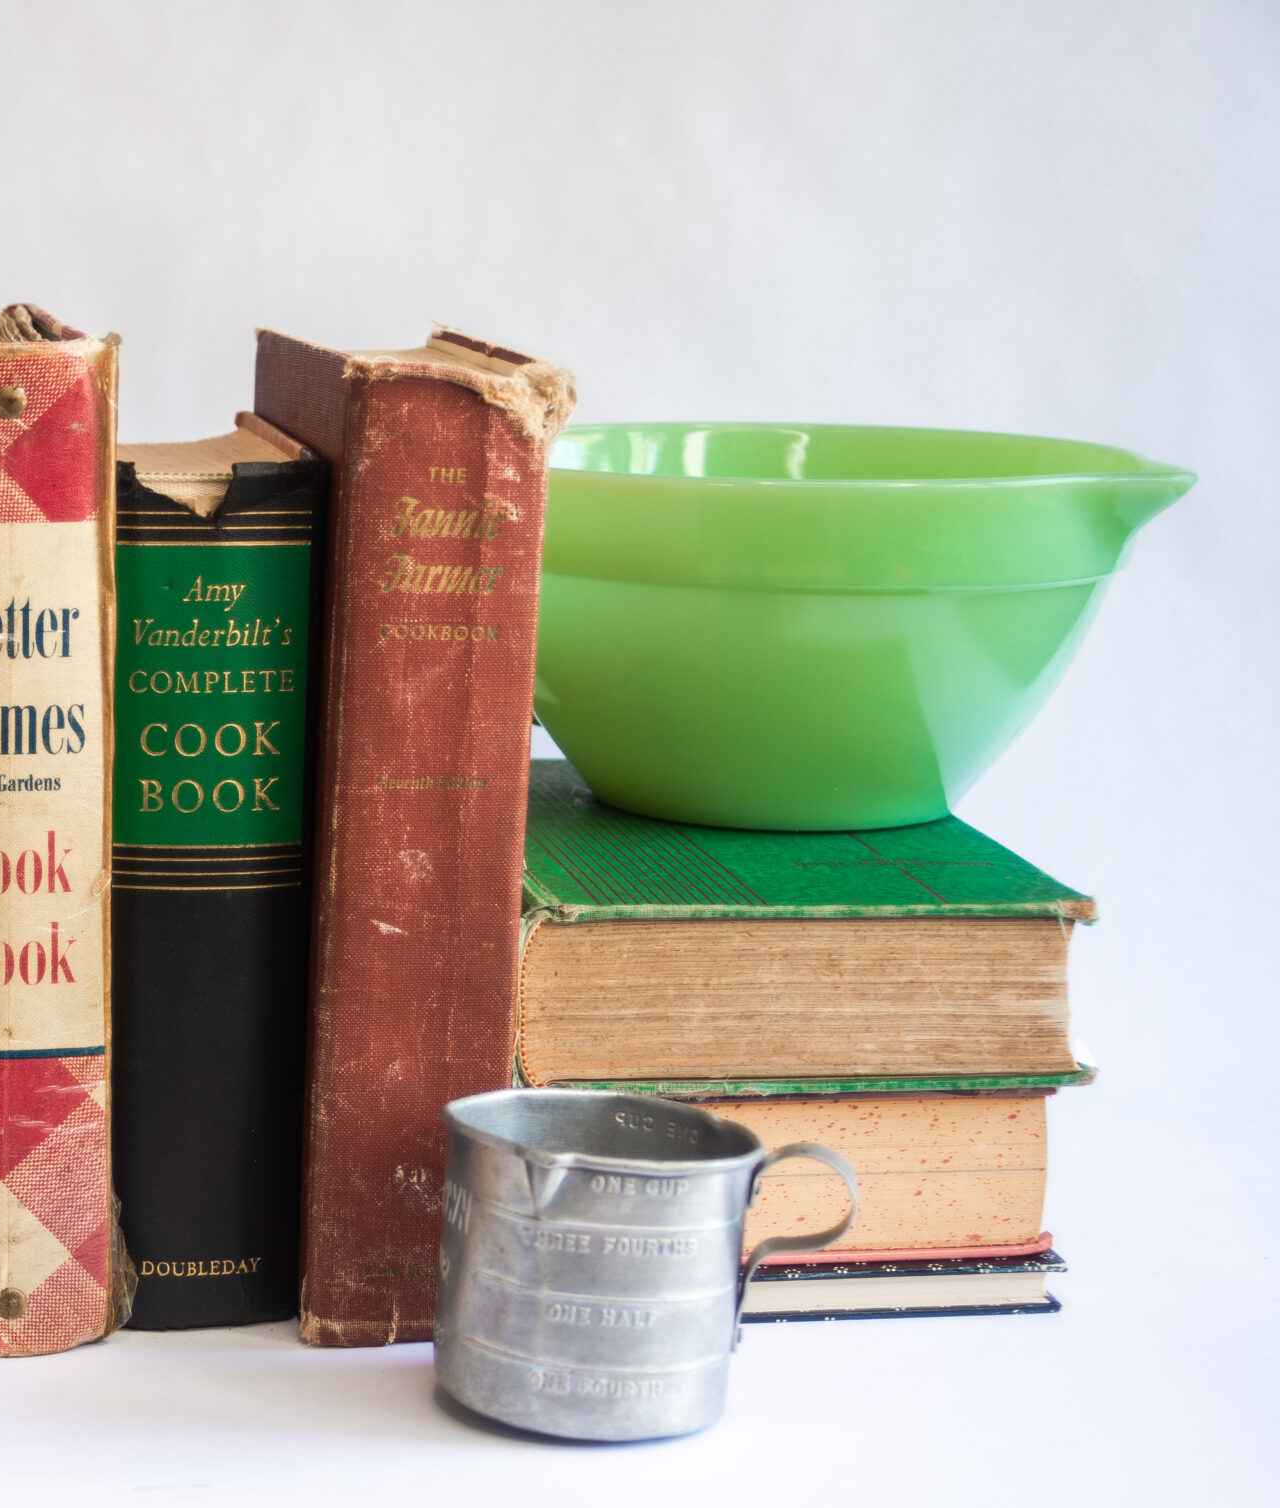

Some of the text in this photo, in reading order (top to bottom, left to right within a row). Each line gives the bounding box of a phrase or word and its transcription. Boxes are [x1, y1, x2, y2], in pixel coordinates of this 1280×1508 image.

[429, 466, 467, 484] THE
[390, 496, 504, 539] Fannie
[381, 552, 504, 595] Farmer
[182, 574, 247, 612] Amy
[133, 617, 293, 647] Vanderbilt's
[379, 624, 500, 642] COOKBOOK
[128, 669, 294, 694] COMPLETE
[139, 720, 281, 758] COOK
[138, 776, 280, 814] BOOK
[590, 1174, 691, 1198] ONE CUP
[520, 1224, 699, 1257] THREE FOURTHS
[140, 1256, 261, 1277] DOUBLEDAY
[546, 1303, 661, 1329] ONE HALF
[528, 1370, 665, 1398] ONE FOURTH
